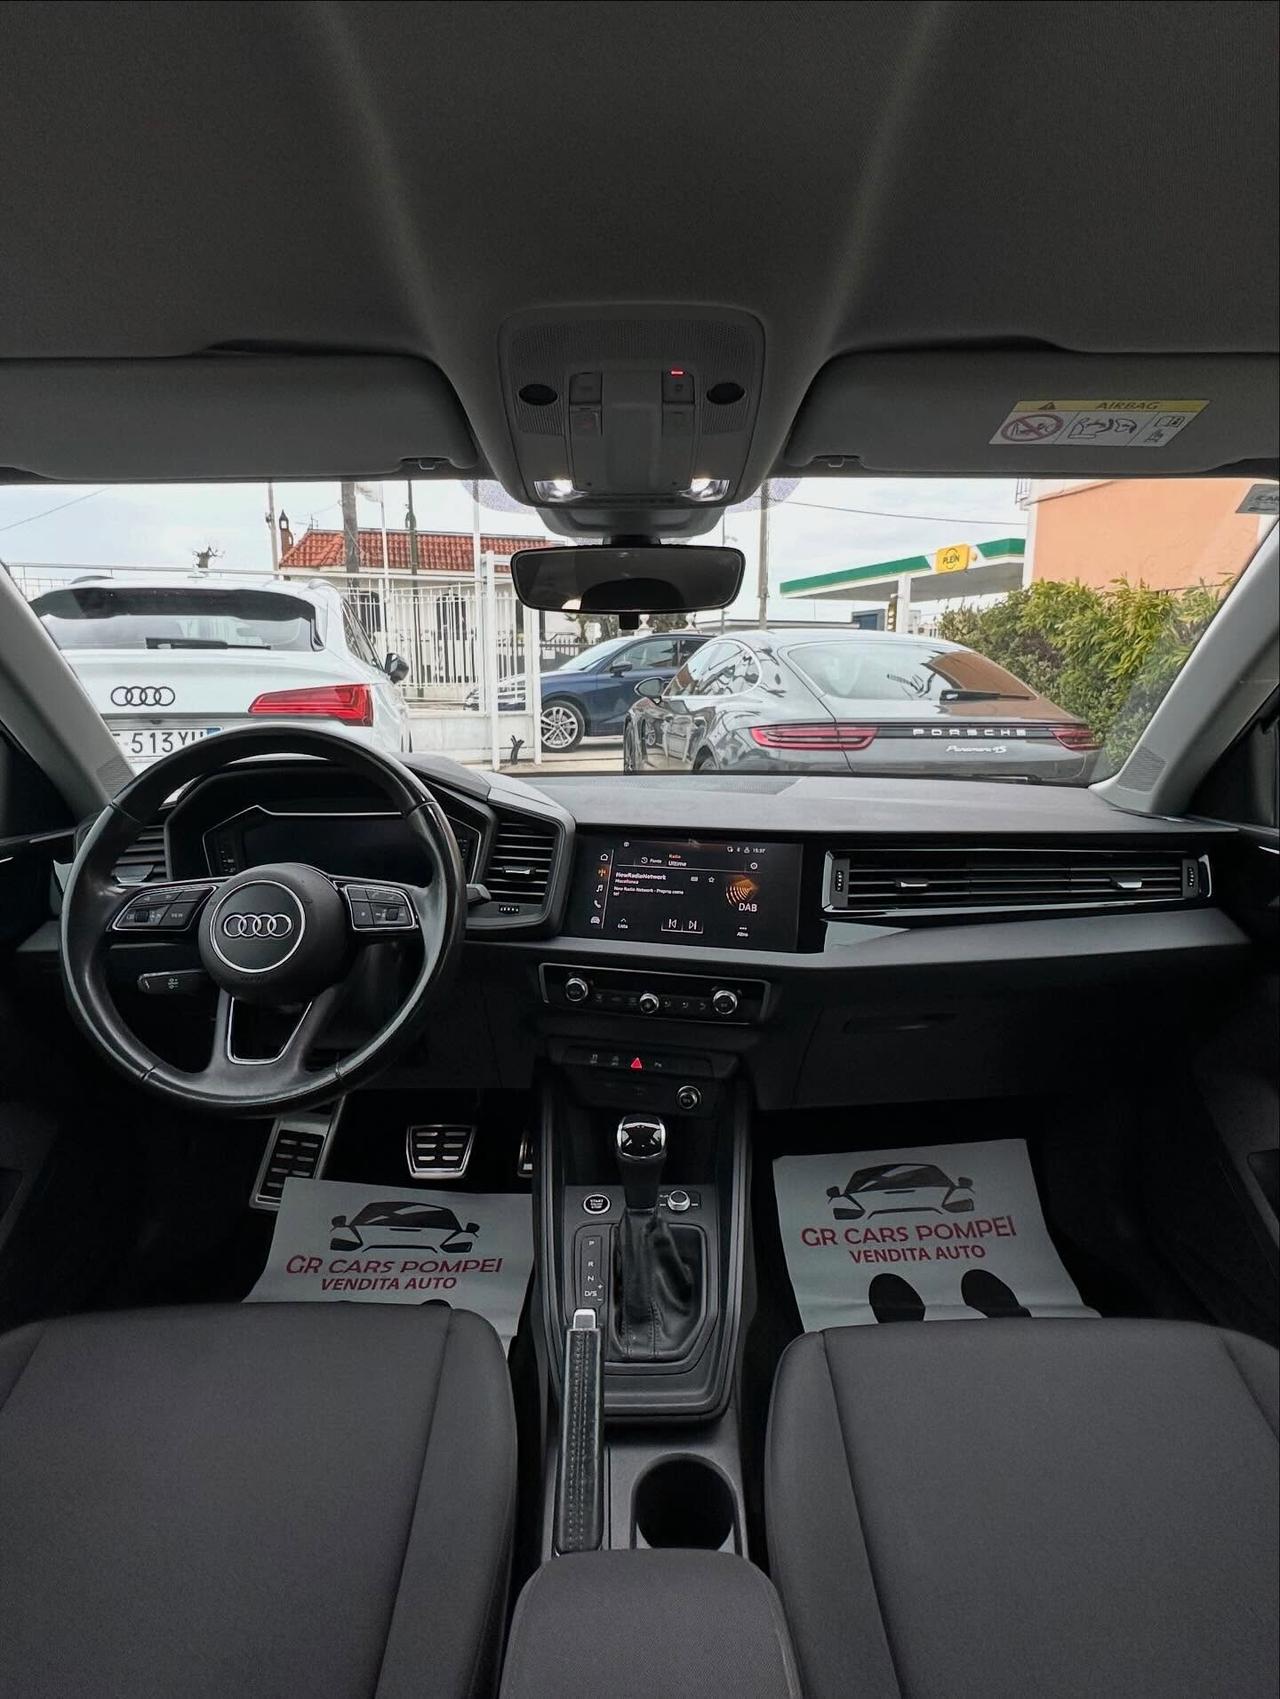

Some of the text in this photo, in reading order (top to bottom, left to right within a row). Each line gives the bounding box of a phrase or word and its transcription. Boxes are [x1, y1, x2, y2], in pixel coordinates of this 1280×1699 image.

[1096, 401, 1160, 410] AIRBAG
[912, 728, 1026, 736] PORSCHE
[131, 731, 204, 754] 513Y
[738, 903, 758, 912] DAB
[801, 1215, 1017, 1247] GR CARS POMPEI
[849, 1244, 986, 1264] VENDITA AUTO
[286, 1254, 504, 1275] GR CARS POMPEI
[320, 1276, 458, 1291] VENDITA AUTO
